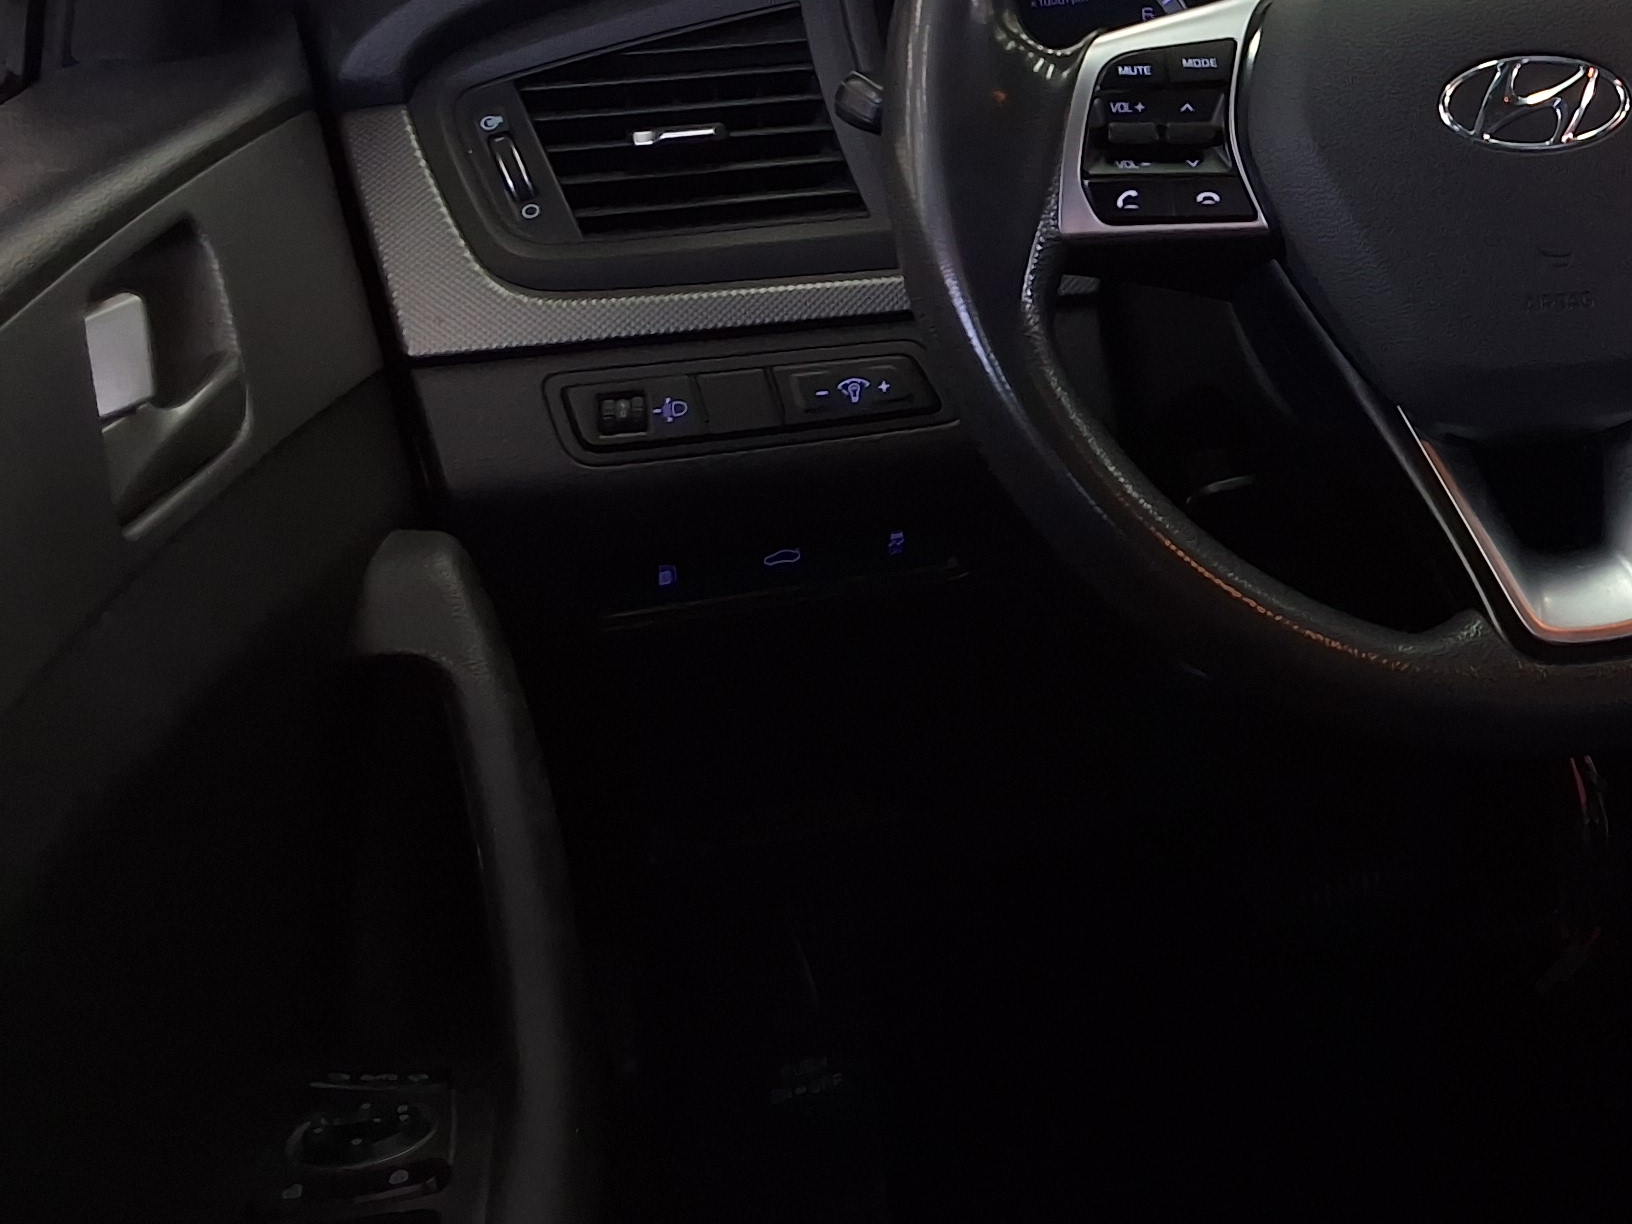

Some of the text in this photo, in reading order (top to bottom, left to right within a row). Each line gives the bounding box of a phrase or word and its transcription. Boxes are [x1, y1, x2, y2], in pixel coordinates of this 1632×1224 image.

[1182, 57, 1218, 68] MODE
[1118, 65, 1152, 76] MUTE
[1109, 101, 1133, 113] VOL
